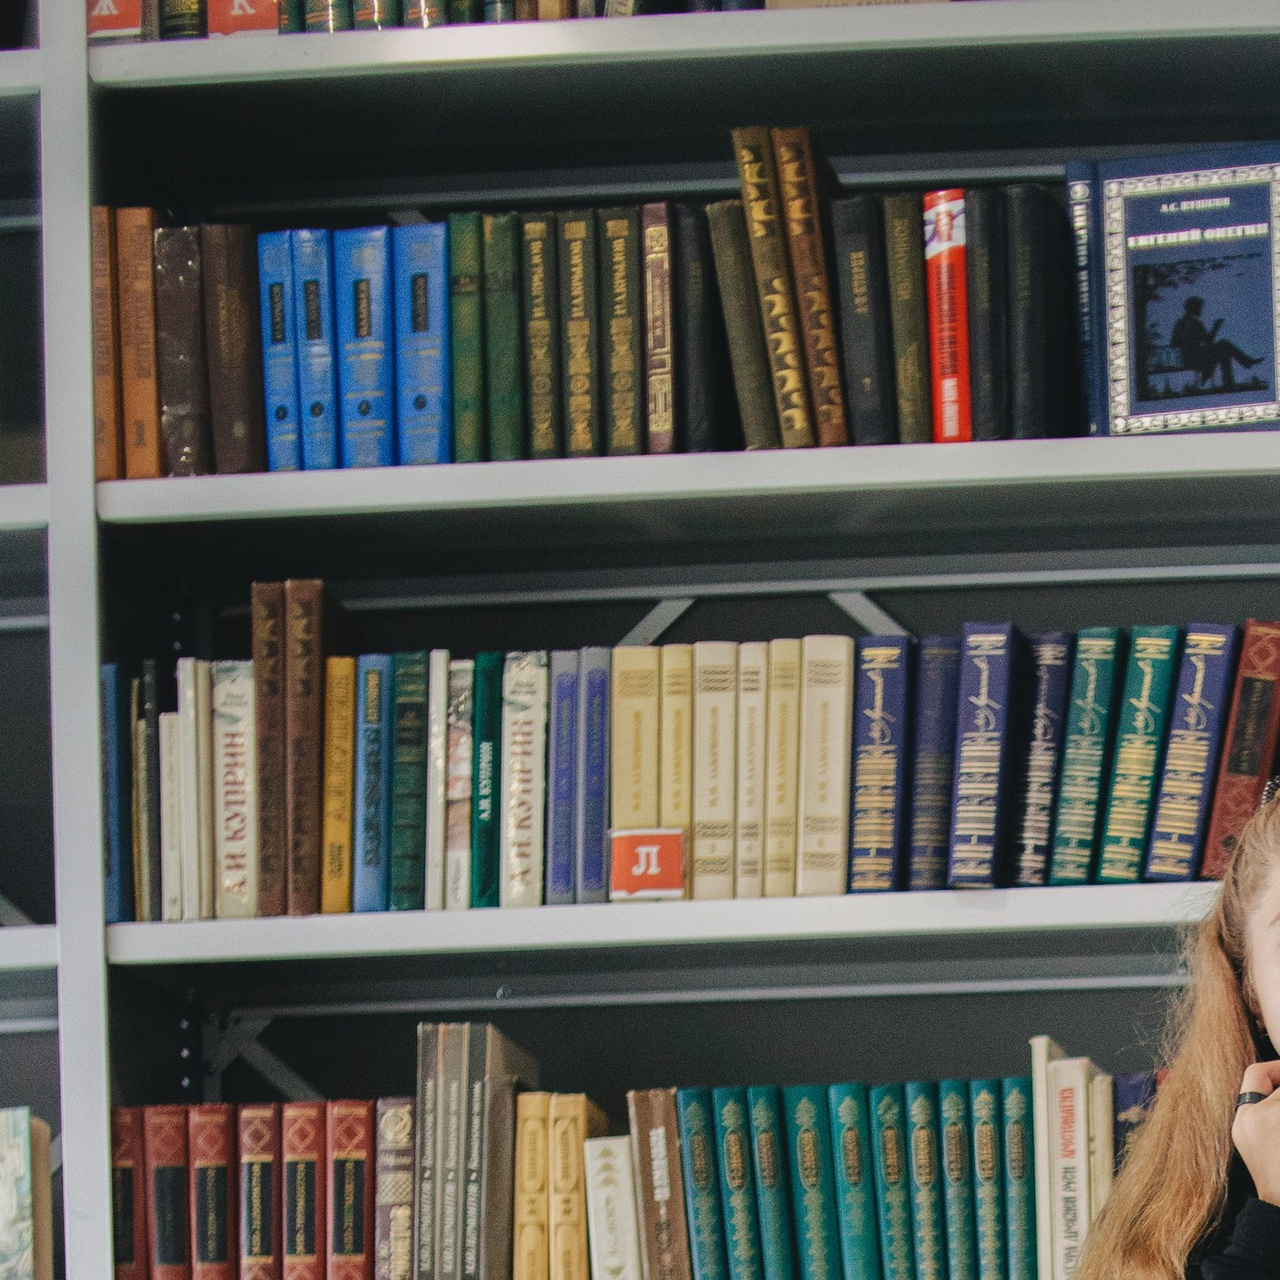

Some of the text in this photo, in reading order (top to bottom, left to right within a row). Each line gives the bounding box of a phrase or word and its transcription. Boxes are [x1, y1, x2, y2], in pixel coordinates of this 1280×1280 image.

[222, 730, 245, 842] КУПРИН
[510, 719, 534, 829] КУПРИН
[631, 844, 661, 876] Л
